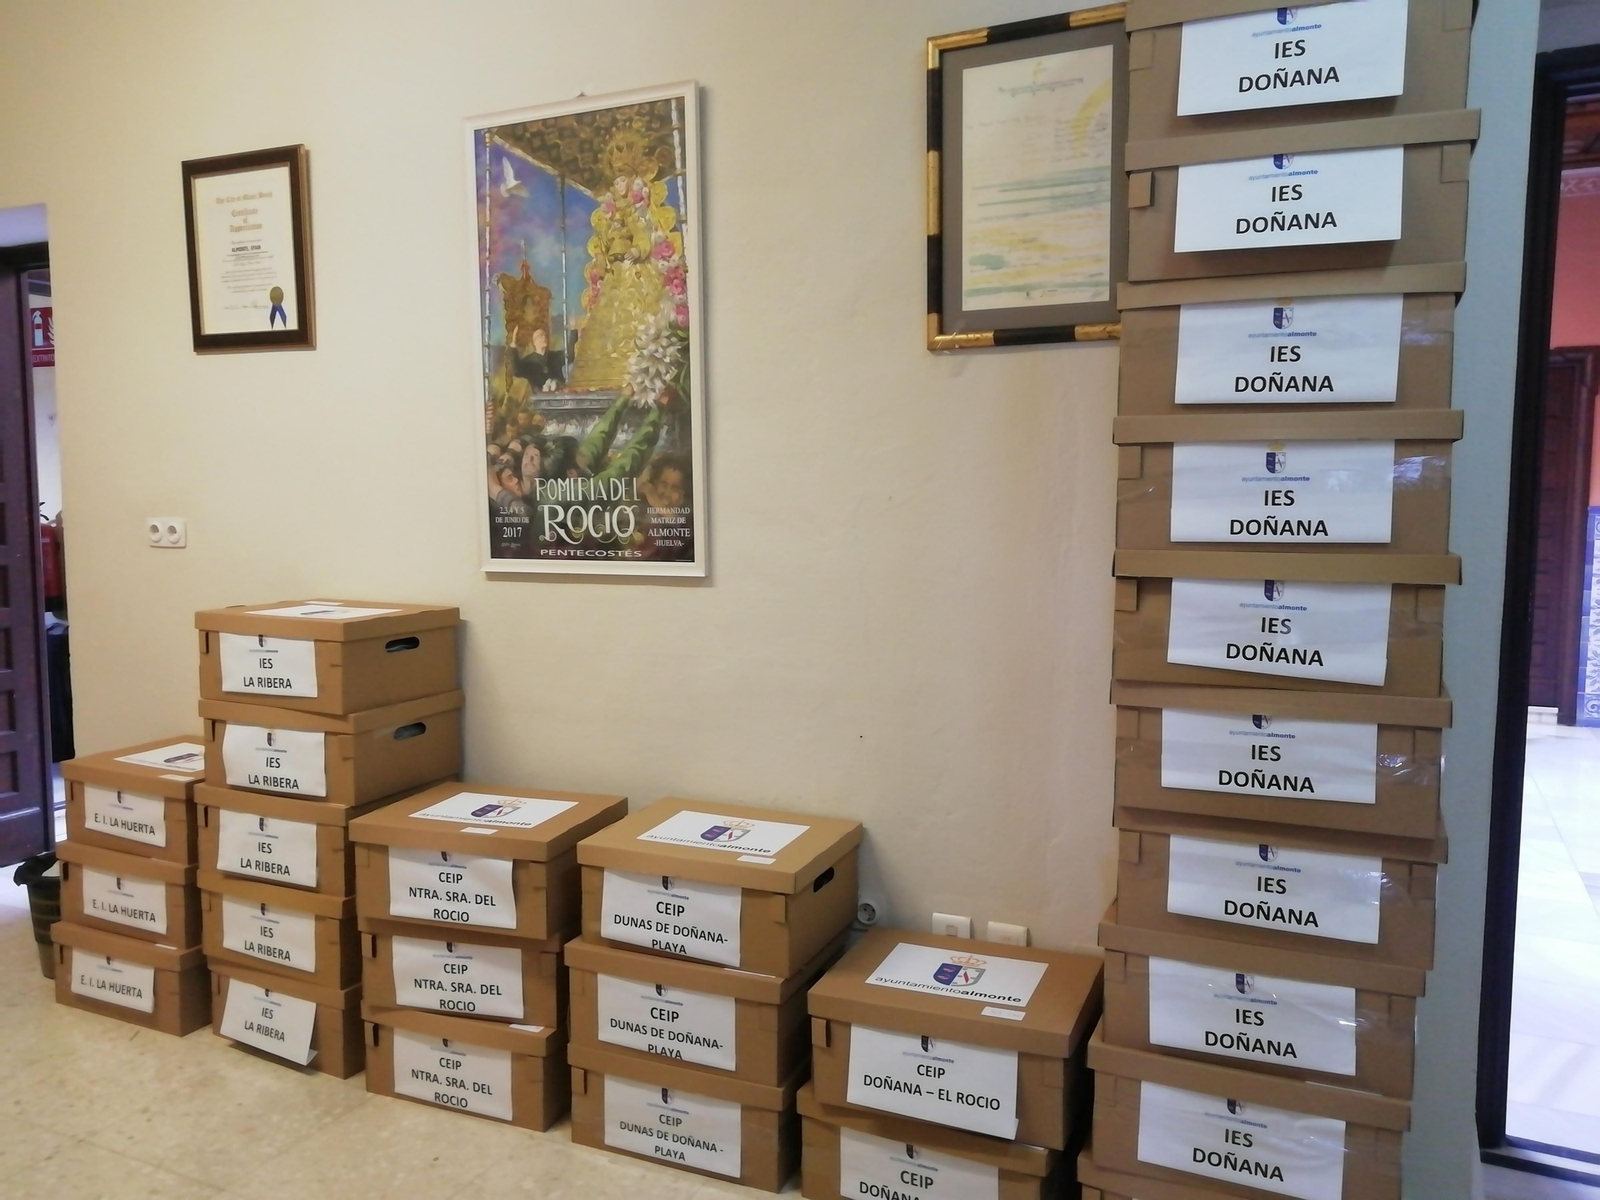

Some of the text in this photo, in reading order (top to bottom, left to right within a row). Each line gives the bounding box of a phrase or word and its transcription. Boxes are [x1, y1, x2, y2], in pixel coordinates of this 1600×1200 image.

[1275, 40, 1305, 59] IES
[1239, 67, 1339, 92] DOÑANA
[1272, 185, 1302, 202] IES
[1237, 211, 1337, 234] DOÑANA
[1271, 346, 1300, 362] IES
[1235, 372, 1333, 392] DOÑANA
[534, 473, 641, 502] ROMERÍA DEL
[1265, 490, 1294, 506] IES
[647, 507, 690, 515] HERMANDAD
[502, 527, 522, 538] 2017
[537, 504, 640, 544] ROCÍO
[648, 527, 690, 537] ALMONTE
[1231, 516, 1328, 536] DOÑANA
[654, 539, 684, 548] -HUELVA-
[541, 548, 642, 558] PENTECOSTÉS
[1262, 617, 1291, 634] IES
[1227, 642, 1323, 666] DOÑANA
[260, 659, 273, 669] IES
[244, 677, 292, 688] LA RIBERA
[1252, 745, 1281, 761] IES
[266, 757, 280, 768] IES
[249, 775, 299, 790] LA RIBERA
[1218, 769, 1315, 793] DOÑANA
[95, 813, 155, 835] E. I. LA HUERTA
[259, 842, 272, 853] IES
[646, 834, 771, 854] ayuntamientoalmonte
[241, 858, 290, 876] LA RIBERA
[439, 872, 462, 883] CEIP
[1258, 877, 1286, 894] IES
[410, 887, 495, 906] NTRA. SRA. DEL
[93, 899, 155, 922] E. I. LA HUERTA
[433, 908, 470, 922] ROCIO
[657, 902, 684, 916] CEIP
[1224, 899, 1319, 928] DOÑANA
[261, 926, 273, 938] IES
[615, 915, 728, 944] DUNAS DE DOÑANA-
[245, 941, 291, 961] LA RIBERA
[651, 938, 687, 955] PLAYA
[444, 964, 467, 974] CEIP
[80, 978, 142, 998] E. I. LA HUERTA
[414, 979, 501, 995] NTRA. SRA. DEL
[875, 976, 1022, 1003] ayuntamientoalmonte
[262, 1008, 273, 1019] IES
[439, 999, 476, 1012] ROCIO
[651, 1008, 679, 1022] CEIP
[1236, 1009, 1264, 1026] IES
[245, 1021, 284, 1041] LA RIBERA
[611, 1019, 723, 1050] DUNAS DE DOÑANA-
[647, 1043, 682, 1060] PLAYA
[1204, 1030, 1297, 1058] DOÑANA
[440, 1058, 461, 1070] CEIP
[917, 1065, 945, 1078] CEIP
[412, 1069, 492, 1095] NTRA. SRA. DEL
[434, 1091, 468, 1108] ROCIO
[864, 1075, 922, 1096] DOÑANA
[939, 1089, 952, 1101] EL
[957, 1092, 1000, 1110] ROCIO
[659, 1114, 682, 1126] CEIP
[620, 1121, 653, 1137] DUNAS
[657, 1130, 668, 1141] DE
[672, 1133, 717, 1154] DOÑANA
[1225, 1129, 1252, 1147] IES
[654, 1145, 686, 1162] PLAYA
[1192, 1147, 1284, 1181] DOÑANA
[901, 1171, 933, 1189] CEIP
[859, 1180, 920, 1200] DOÑAN
